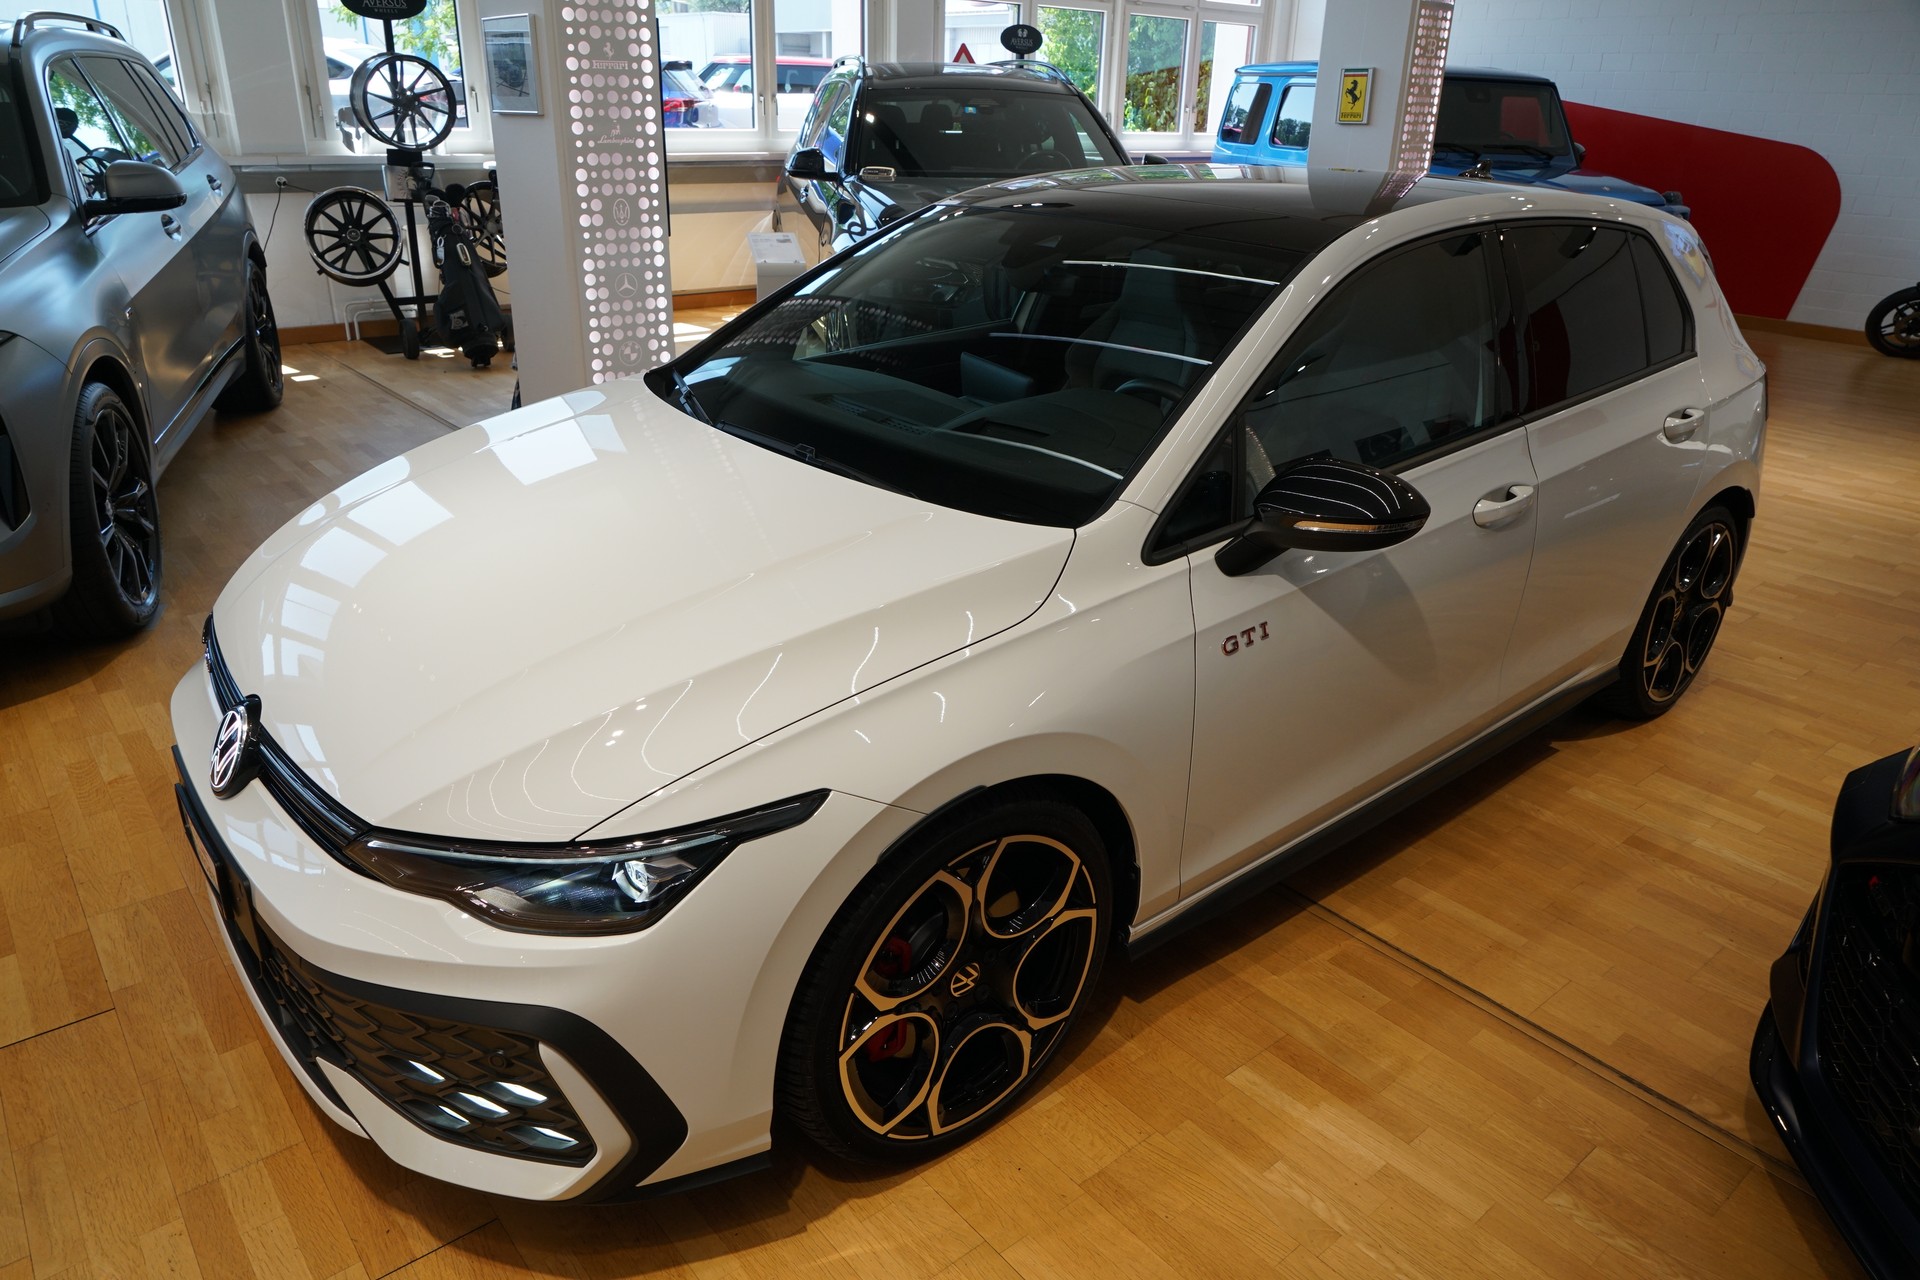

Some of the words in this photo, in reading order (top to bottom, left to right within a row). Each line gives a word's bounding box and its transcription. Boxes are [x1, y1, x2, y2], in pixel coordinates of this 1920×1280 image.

[362, 0, 408, 8] AVERSUS
[592, 60, 629, 70] Ferrari
[1221, 621, 1270, 657] GTI
